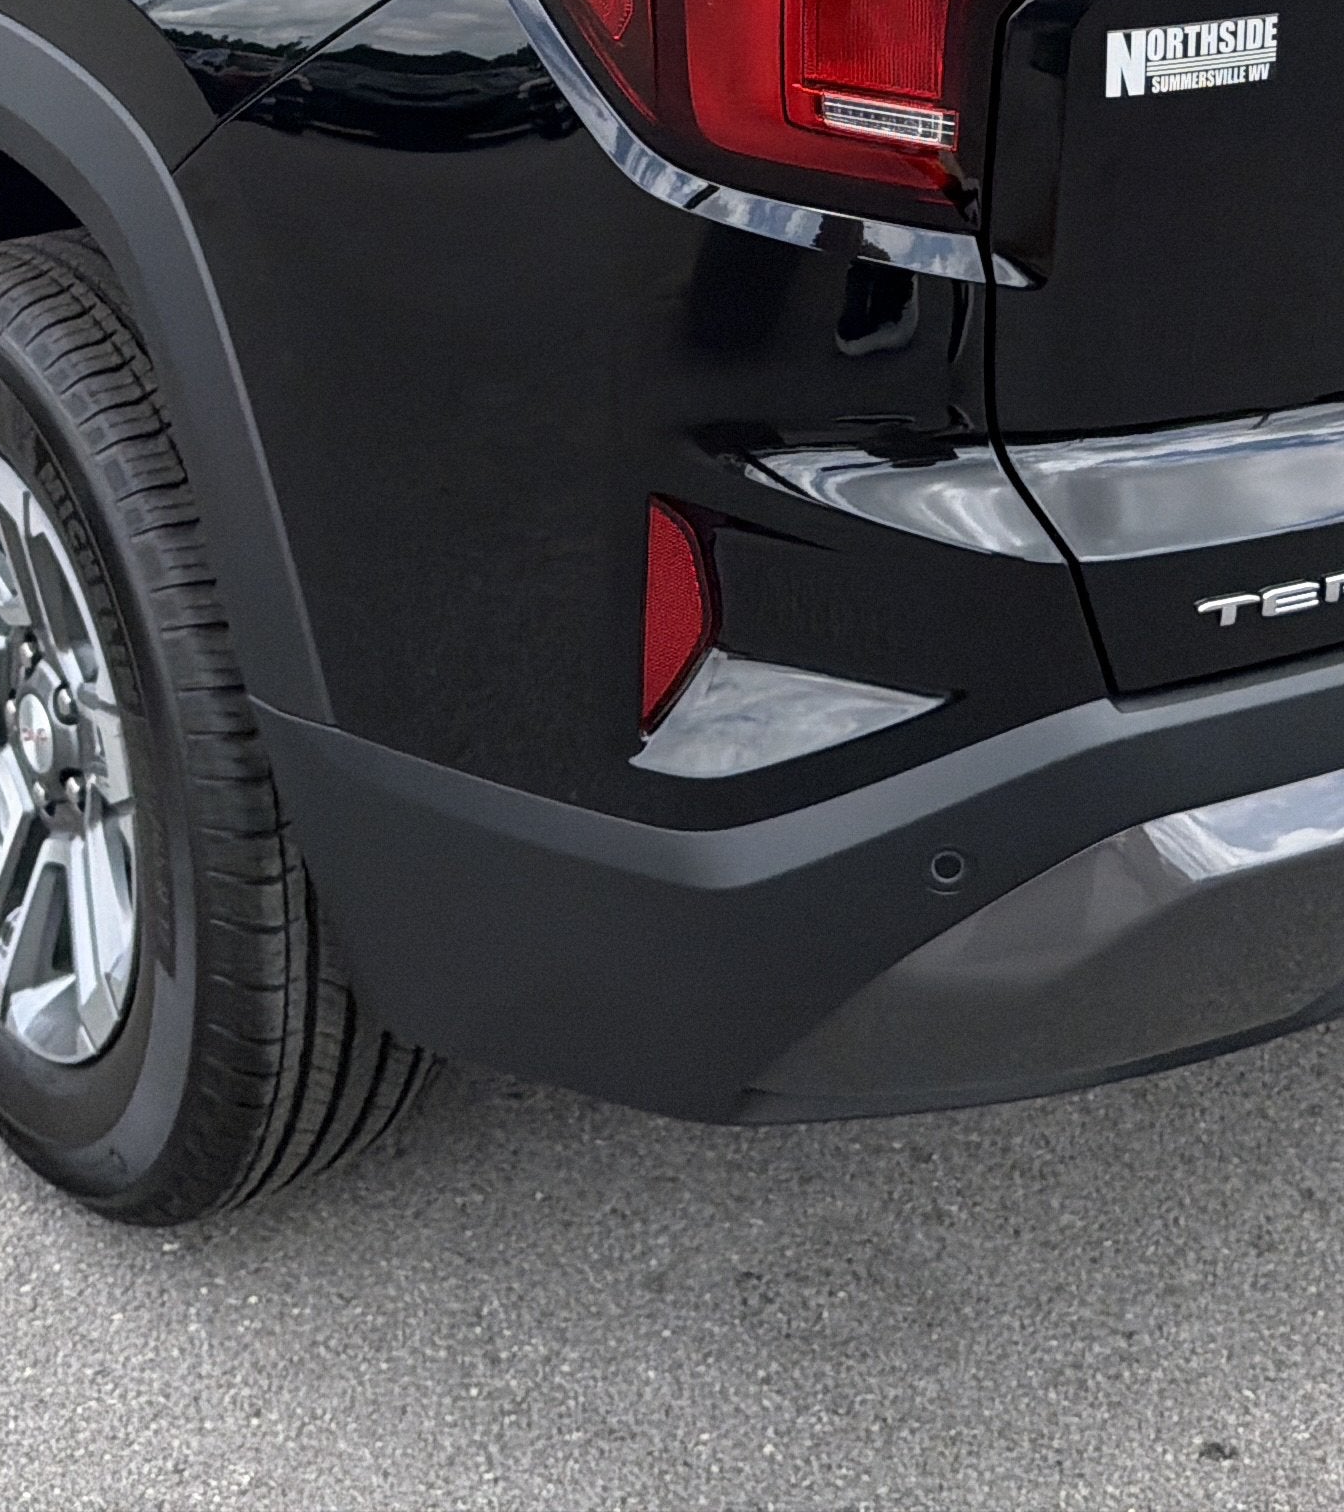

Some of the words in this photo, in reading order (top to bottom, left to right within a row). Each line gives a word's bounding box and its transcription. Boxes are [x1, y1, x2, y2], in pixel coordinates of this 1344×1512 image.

[1106, 15, 1279, 98] NORTHSIDE
[1151, 65, 1247, 94] SUMMERSVILLE
[1247, 63, 1271, 82] WV
